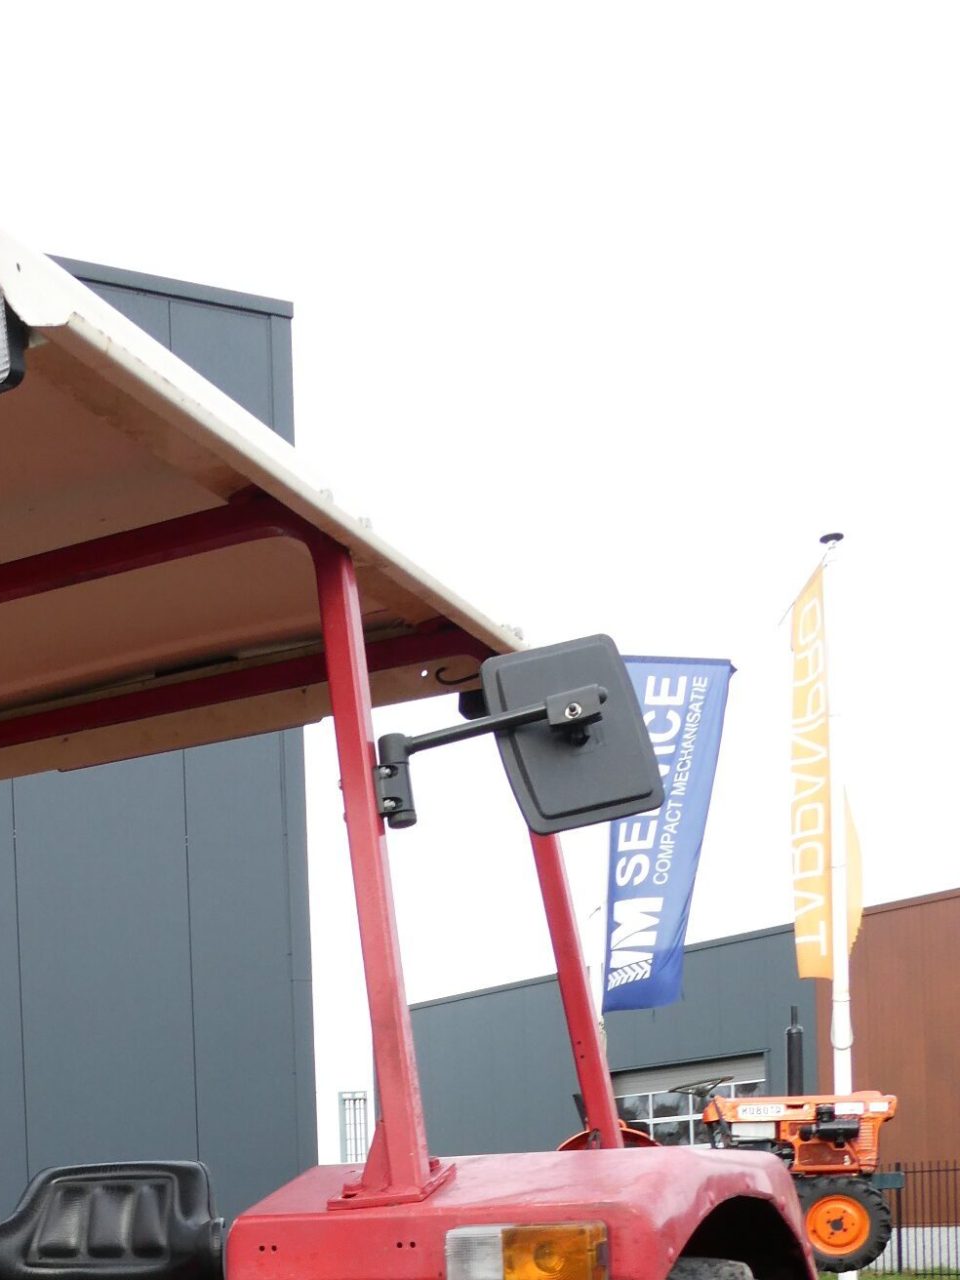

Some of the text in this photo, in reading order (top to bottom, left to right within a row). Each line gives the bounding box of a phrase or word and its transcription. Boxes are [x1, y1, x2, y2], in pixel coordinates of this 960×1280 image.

[615, 675, 687, 886] SEICE
[653, 675, 708, 885] COMPACT MECHANISATIE
[742, 1106, 782, 1115] KUBO
